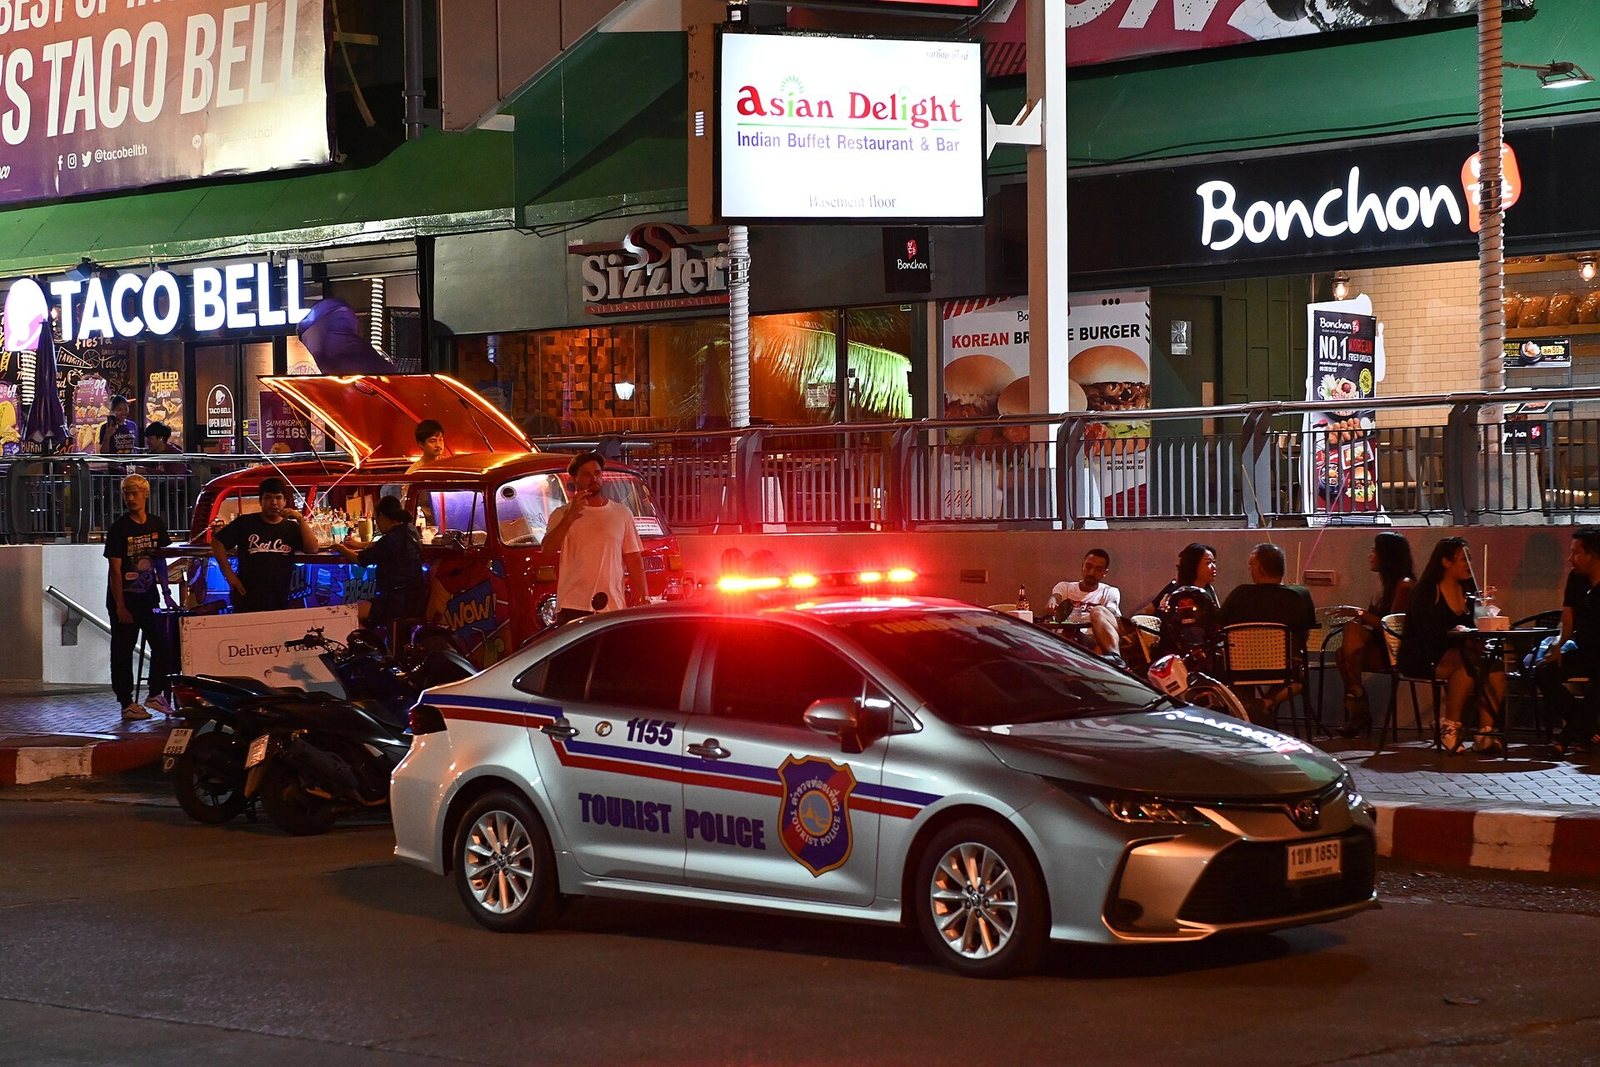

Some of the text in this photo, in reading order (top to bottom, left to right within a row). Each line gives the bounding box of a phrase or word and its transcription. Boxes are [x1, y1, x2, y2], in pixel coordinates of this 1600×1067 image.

[0, 0, 301, 146] S TACO BELL
[849, 91, 963, 129] Delight
[737, 131, 960, 152] Indian Buffet Restaurant & Bar
[95, 144, 148, 163] @tacobellth
[809, 194, 897, 208] Basement floor
[1196, 165, 1462, 251] Bonchon
[582, 246, 730, 302] Sizzler
[896, 258, 928, 270] Bonchon
[51, 258, 312, 341] TACO BELL
[590, 304, 622, 313] STEAK
[631, 300, 677, 311] SEAFOOD
[1319, 317, 1352, 330] Bonchon
[951, 332, 1009, 349] KOREAN
[1079, 323, 1140, 341] BURGER
[1319, 334, 1349, 361] NO.1
[149, 371, 178, 383] GRILLED
[150, 382, 178, 393] CHEESE
[208, 418, 220, 428] OPEN
[265, 427, 276, 439] 2
[285, 427, 308, 439] 169
[248, 534, 272, 550] Red
[228, 643, 282, 658] Delivery
[626, 717, 677, 747] 1155
[578, 793, 766, 850] TOURIST POLICE
[790, 808, 841, 847] TOURIST POLICE
